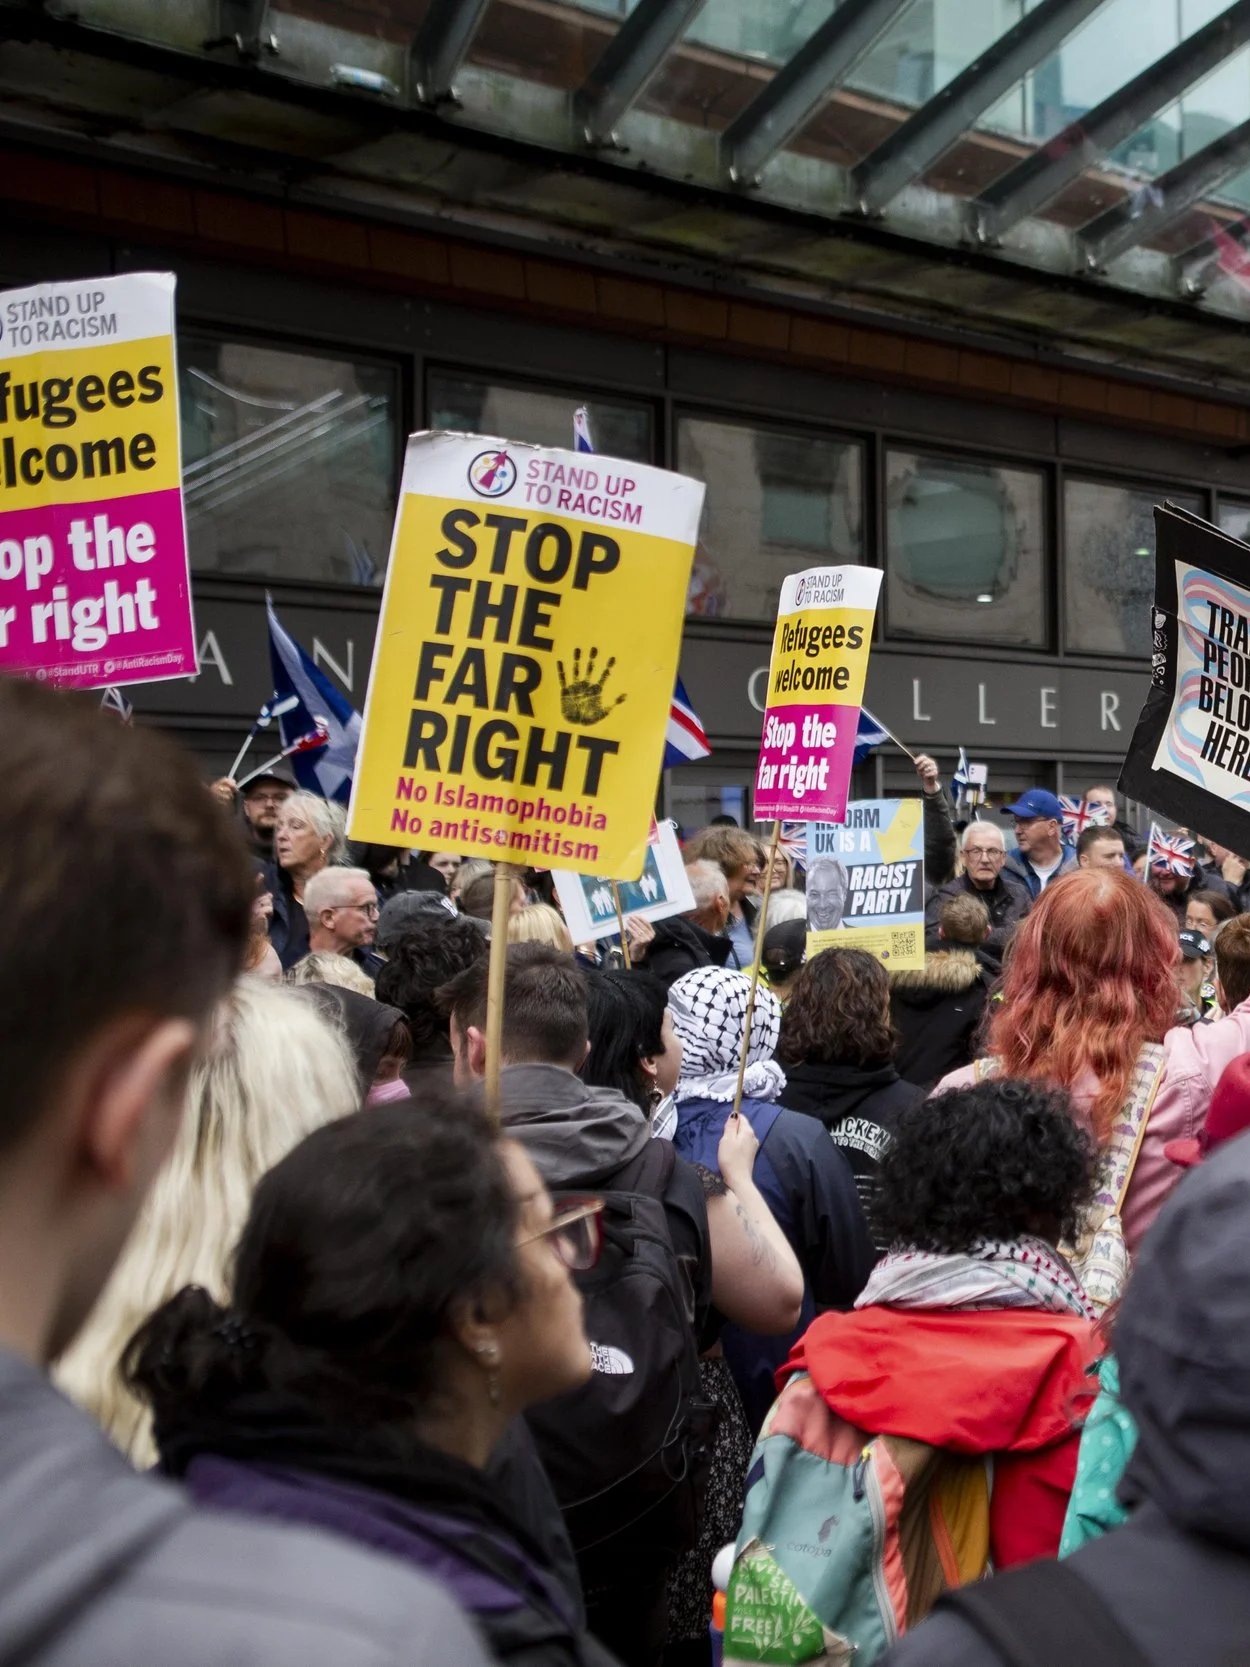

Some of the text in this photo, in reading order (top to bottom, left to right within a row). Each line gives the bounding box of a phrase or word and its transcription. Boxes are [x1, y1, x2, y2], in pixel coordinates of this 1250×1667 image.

[6, 291, 105, 324] STAND UP
[8, 313, 117, 348] TO RACISM
[0, 365, 164, 429] fugees
[0, 433, 156, 488] lcome
[526, 459, 636, 498] STAND UP
[524, 481, 643, 525] TO RACISM
[0, 513, 156, 591] op the
[435, 508, 621, 591] STOP
[805, 588, 844, 604] TO RACISM
[807, 574, 843, 588] STAND UP
[31, 578, 160, 651] right
[429, 574, 561, 651] THE
[780, 618, 864, 657] Refugees
[414, 641, 542, 718] FAR
[774, 659, 850, 693] welcome
[403, 708, 620, 797] RIGHT
[764, 714, 837, 755] Stop the
[757, 756, 830, 798] far right
[395, 776, 607, 832] No Islamophobia
[390, 808, 600, 862] No antisemitism
[815, 831, 871, 852] UK IS A
[850, 863, 916, 890] RACIST
[851, 888, 912, 915] PARTY
[735, 1584, 806, 1606] PALESTIN
[731, 1616, 772, 1635] FREE
